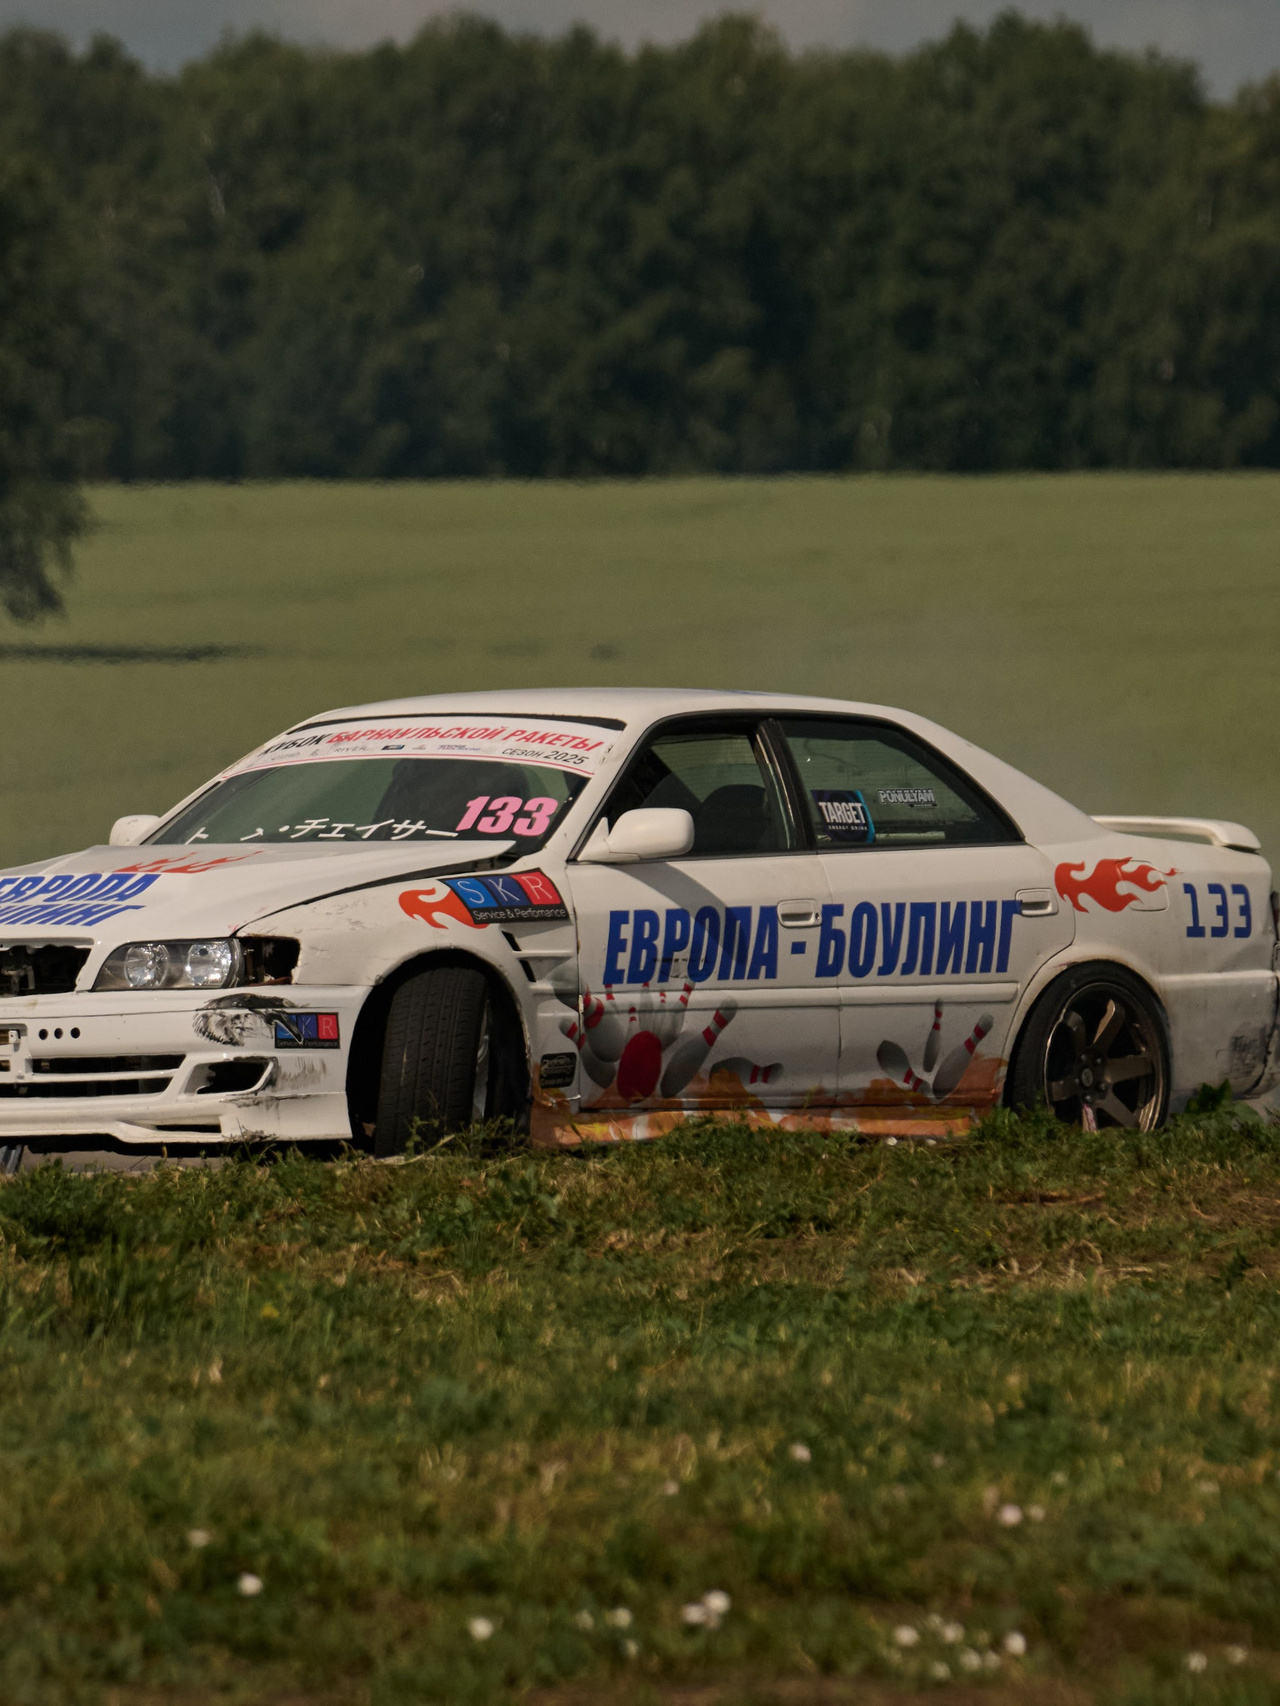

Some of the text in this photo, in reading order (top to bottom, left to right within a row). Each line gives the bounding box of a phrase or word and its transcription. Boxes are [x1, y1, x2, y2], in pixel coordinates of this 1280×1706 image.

[258, 726, 604, 757] КУБОК БАРНАУЛЬСКОЙ РАКЕТЫ
[502, 748, 590, 765] СЕЗОН 2025
[455, 796, 559, 836] 133
[818, 801, 866, 824] TARGET
[457, 876, 553, 903] SKR
[473, 909, 507, 920] Service
[1183, 883, 1252, 938] 133
[603, 905, 779, 985] ЕВРОПА
[814, 900, 1022, 979] БОУЛИНГ
